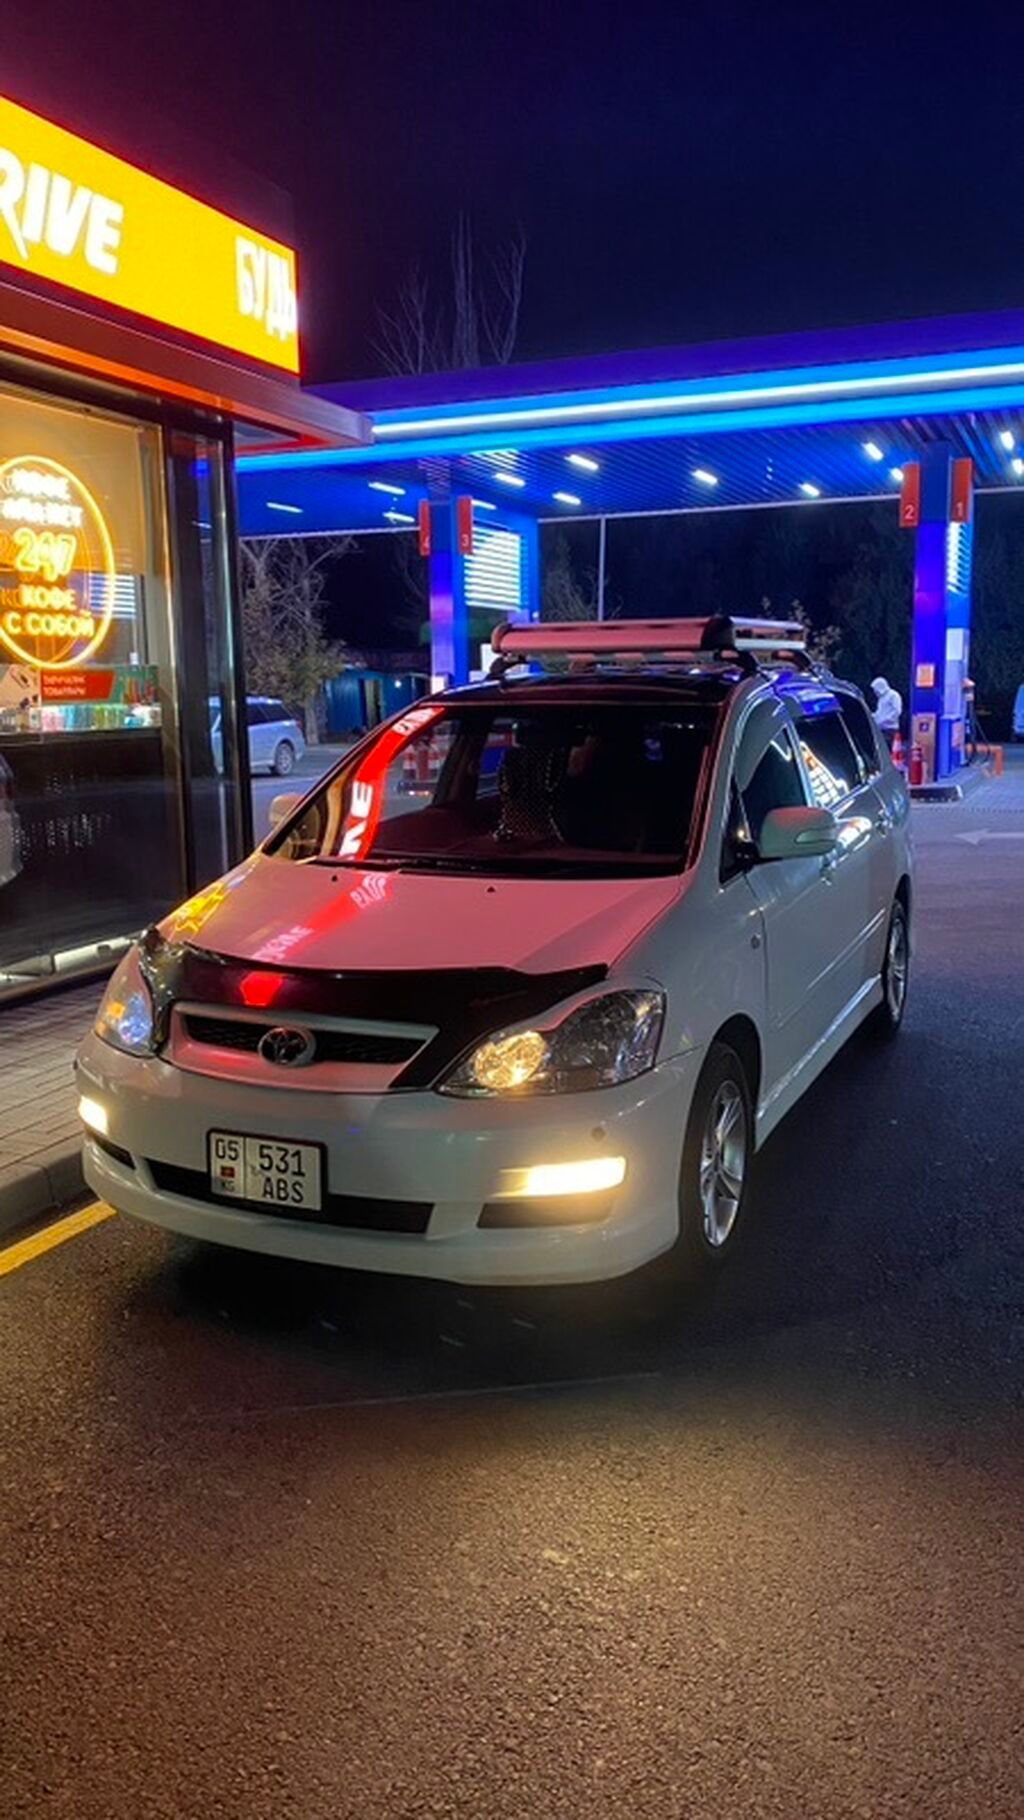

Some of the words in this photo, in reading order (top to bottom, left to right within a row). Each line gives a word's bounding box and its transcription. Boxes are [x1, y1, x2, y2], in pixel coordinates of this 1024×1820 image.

[905, 504, 914, 519] 2
[461, 534, 470, 548] 3
[19, 584, 77, 610] КОФЕ
[25, 609, 95, 637] СОБОЙ
[215, 1138, 239, 1161] 05
[259, 1144, 306, 1178] 531
[262, 1177, 304, 1204] ABS
